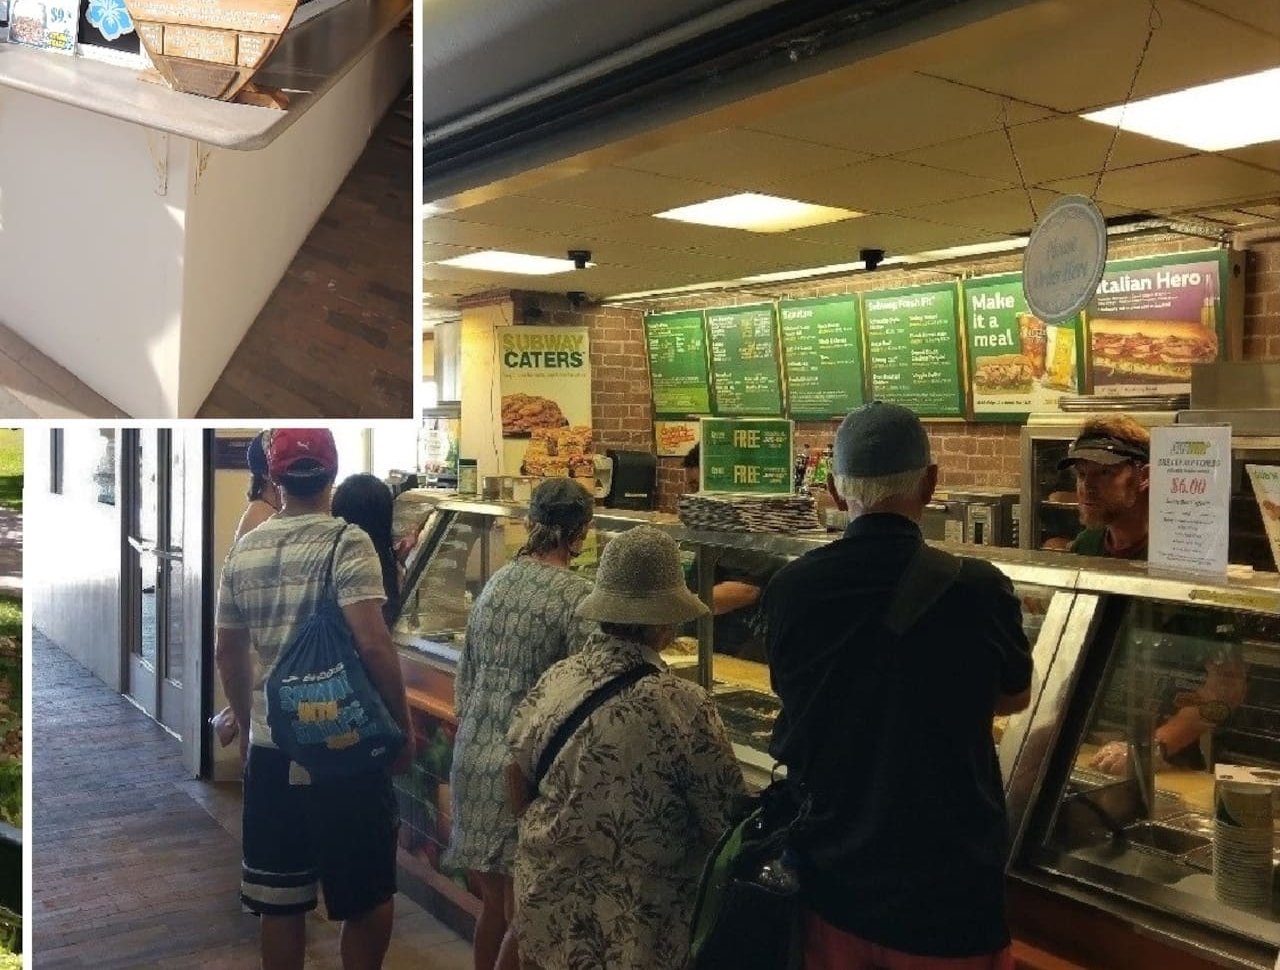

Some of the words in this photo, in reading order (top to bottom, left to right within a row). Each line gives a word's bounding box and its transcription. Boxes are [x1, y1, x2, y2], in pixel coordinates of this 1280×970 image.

[1096, 274, 1152, 294] Italian
[1156, 271, 1201, 289] Hero
[972, 292, 1015, 311] Make
[973, 313, 985, 329] it
[988, 316, 999, 329] a
[502, 332, 584, 351] SUBWAY
[974, 329, 1014, 347] meal
[504, 351, 583, 369] CATERS
[733, 429, 761, 448] FREE
[733, 465, 761, 484] FREE
